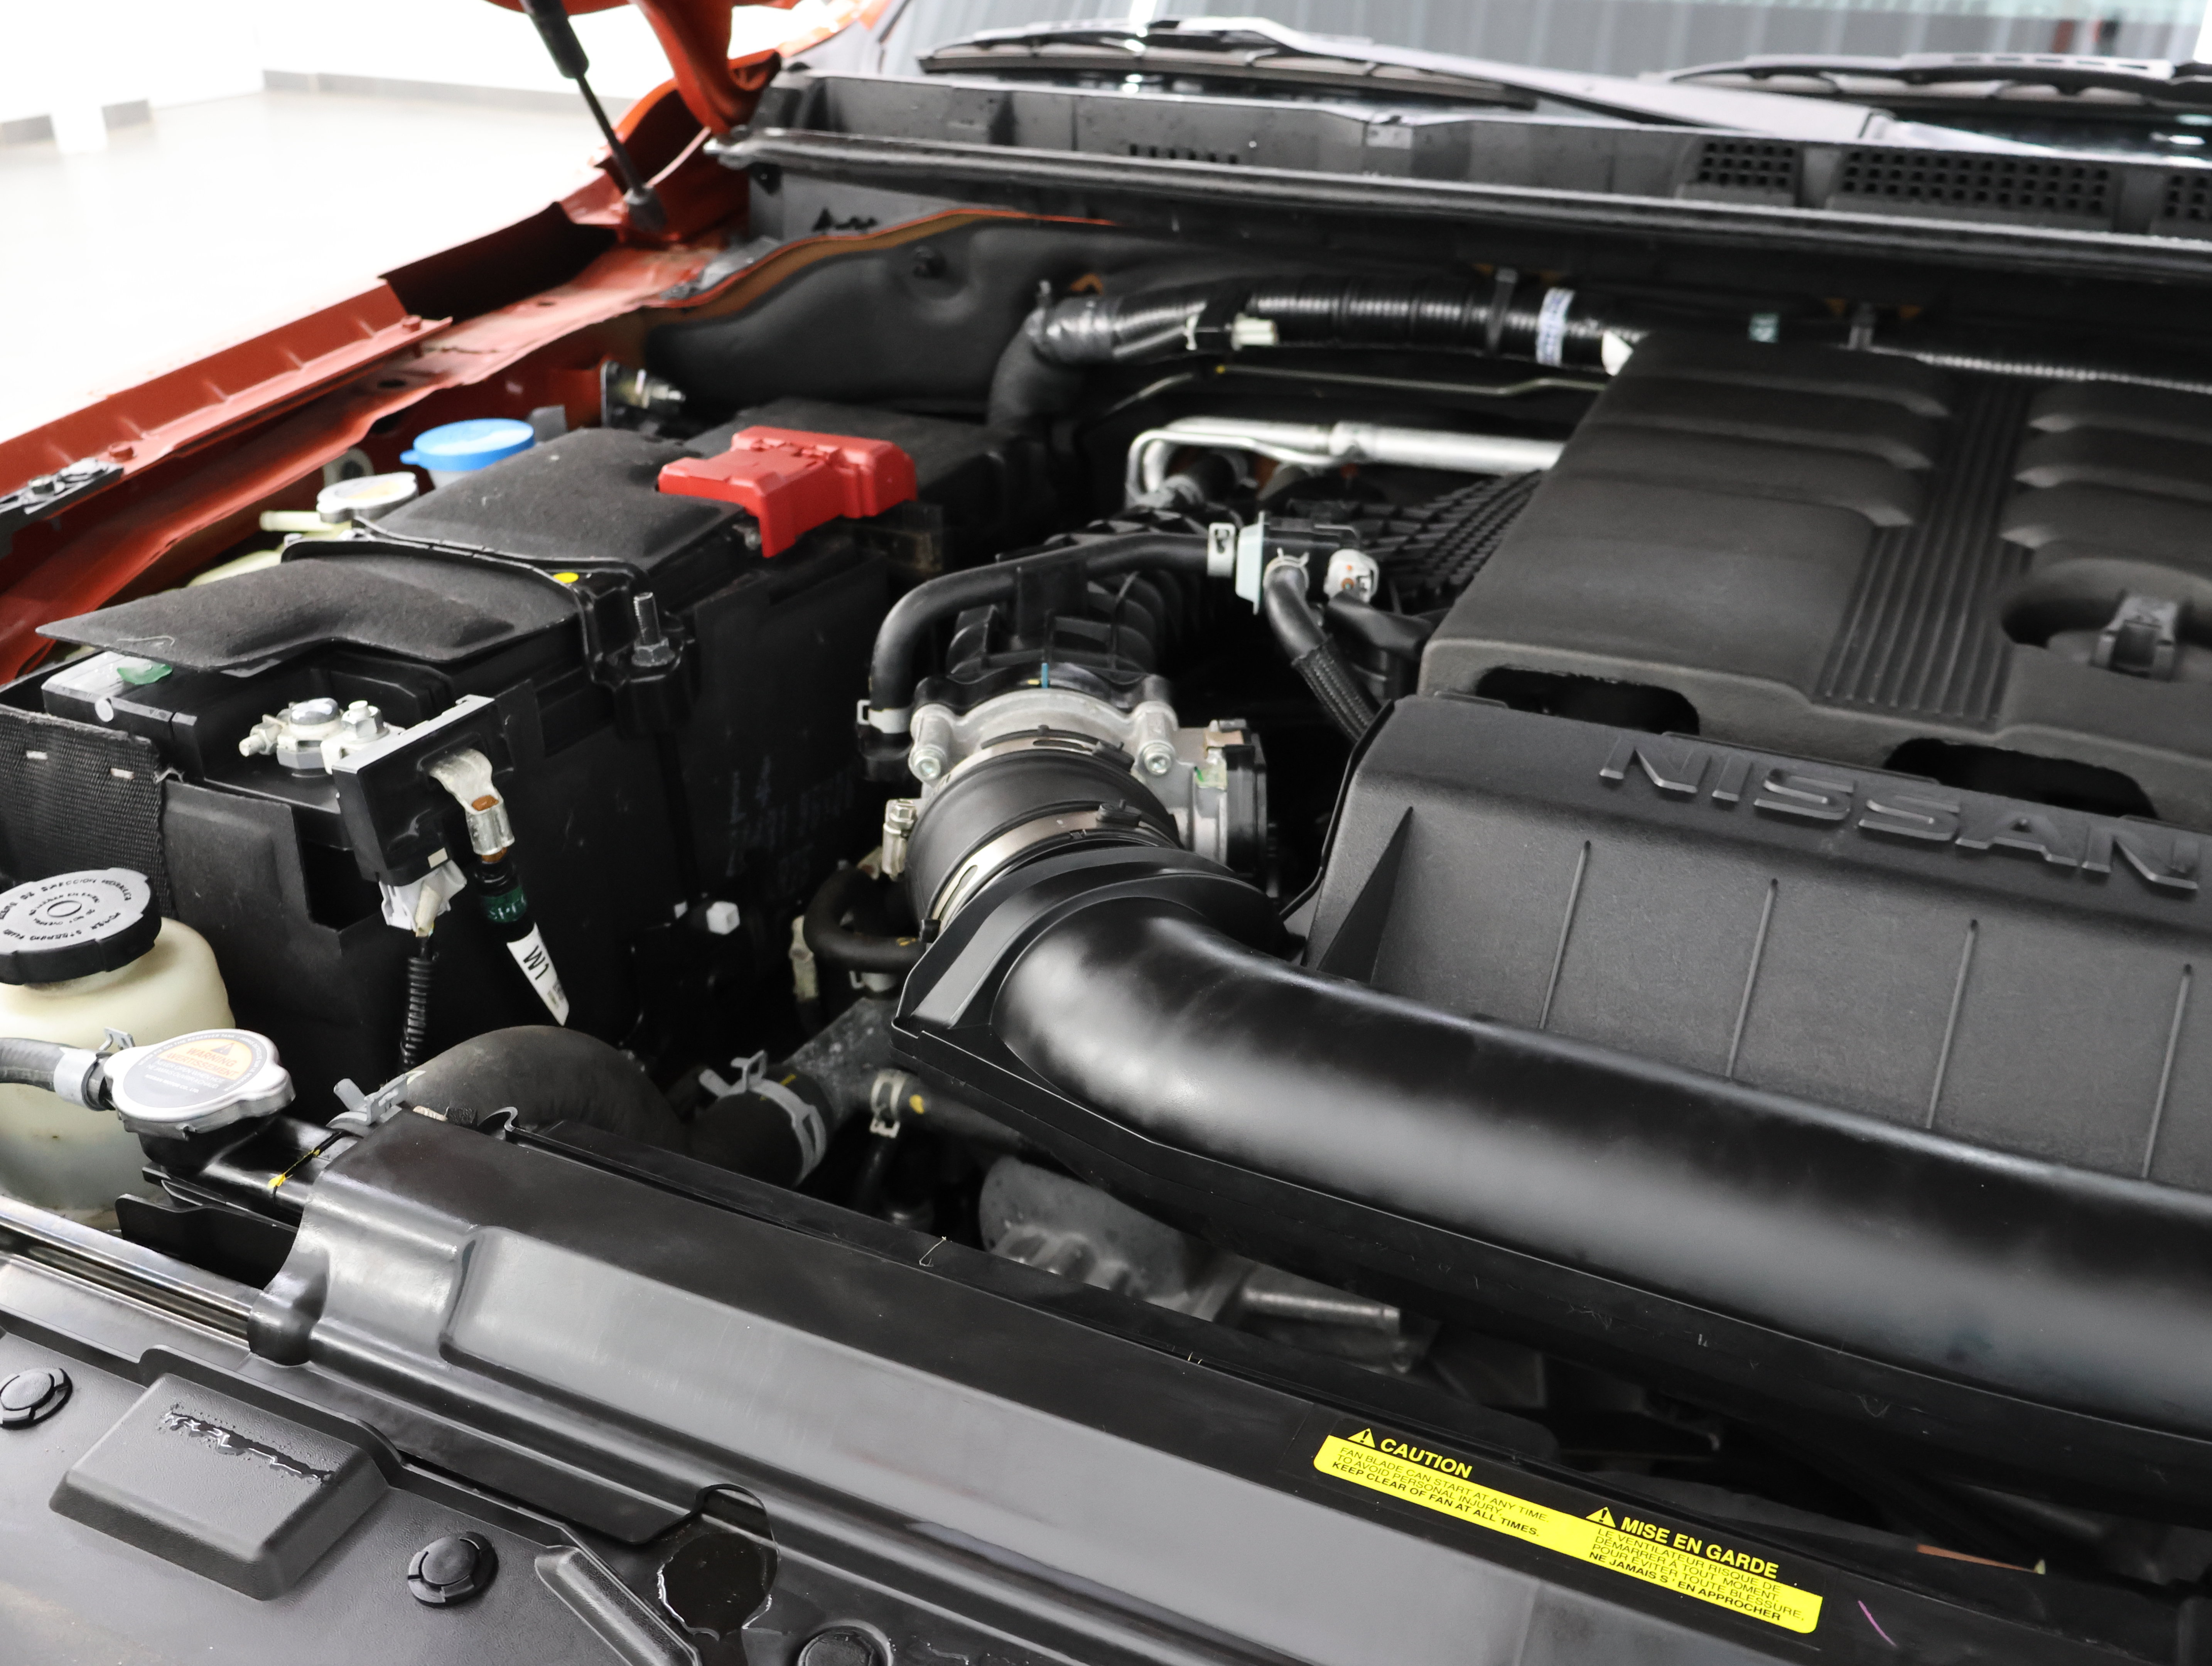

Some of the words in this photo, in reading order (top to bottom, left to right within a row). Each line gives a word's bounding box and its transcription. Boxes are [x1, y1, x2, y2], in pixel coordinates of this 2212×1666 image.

[1598, 737, 2202, 891] NISSAN
[166, 1052, 240, 1077] AVERTISSEMENT
[186, 1048, 238, 1067] WARNING
[1338, 1454, 1353, 1464] TO
[1353, 1460, 1390, 1477] AVOID
[1393, 1472, 1455, 1499] PERSONAL
[1341, 1447, 1363, 1460] FAN
[1366, 1455, 1403, 1473] BLADE
[1406, 1468, 1431, 1482] CAN
[1434, 1478, 1472, 1495] START
[1473, 1491, 1489, 1500] AT
[1491, 1497, 1516, 1509] ANY
[1519, 1506, 1549, 1522] TIME.
[1380, 1438, 1473, 1478] CAUTION
[1333, 1462, 1364, 1476] KEEP
[1367, 1472, 1406, 1491] CLEAR
[1410, 1486, 1426, 1497] OF
[1429, 1494, 1453, 1506] FAN
[1455, 1503, 1471, 1512] AT
[1473, 1509, 1496, 1522] ALL
[1501, 1517, 1539, 1536] TIMES.
[1593, 1545, 1628, 1560] POUR
[1682, 1573, 1726, 1593] TOUTE
[1598, 1528, 1613, 1538] LE
[1618, 1535, 1705, 1568] VENTILATEUR
[1708, 1564, 1759, 1587] RISQUE
[1762, 1582, 1781, 1593] DE
[1621, 1517, 1670, 1543] MISE
[1674, 1533, 1702, 1554] EN
[1706, 1544, 1779, 1579] GARDE
[1682, 1565, 1716, 1579] TOUT
[1589, 1551, 1606, 1562] NE
[1609, 1558, 1657, 1579] JAMAIS
[1698, 1588, 1780, 1620] APPROCHER
